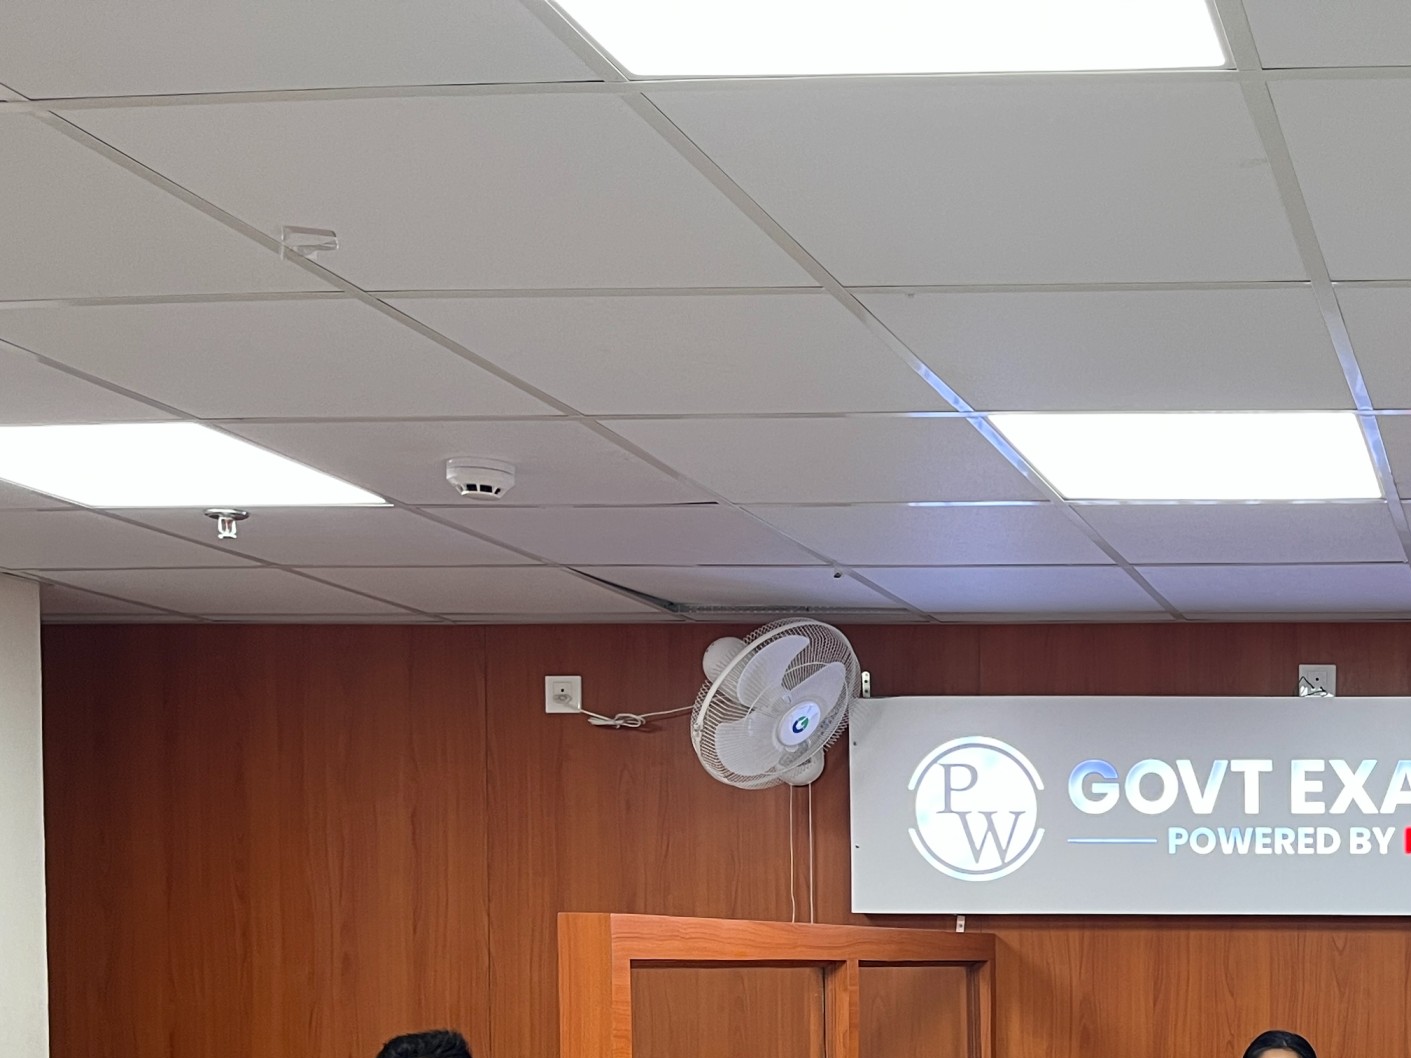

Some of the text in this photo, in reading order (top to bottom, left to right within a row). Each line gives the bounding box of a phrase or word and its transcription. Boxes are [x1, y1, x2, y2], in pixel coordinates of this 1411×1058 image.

[1068, 759, 1273, 815] GOVT
[1168, 826, 1341, 855] POWERED
[1349, 826, 1396, 855] BY
